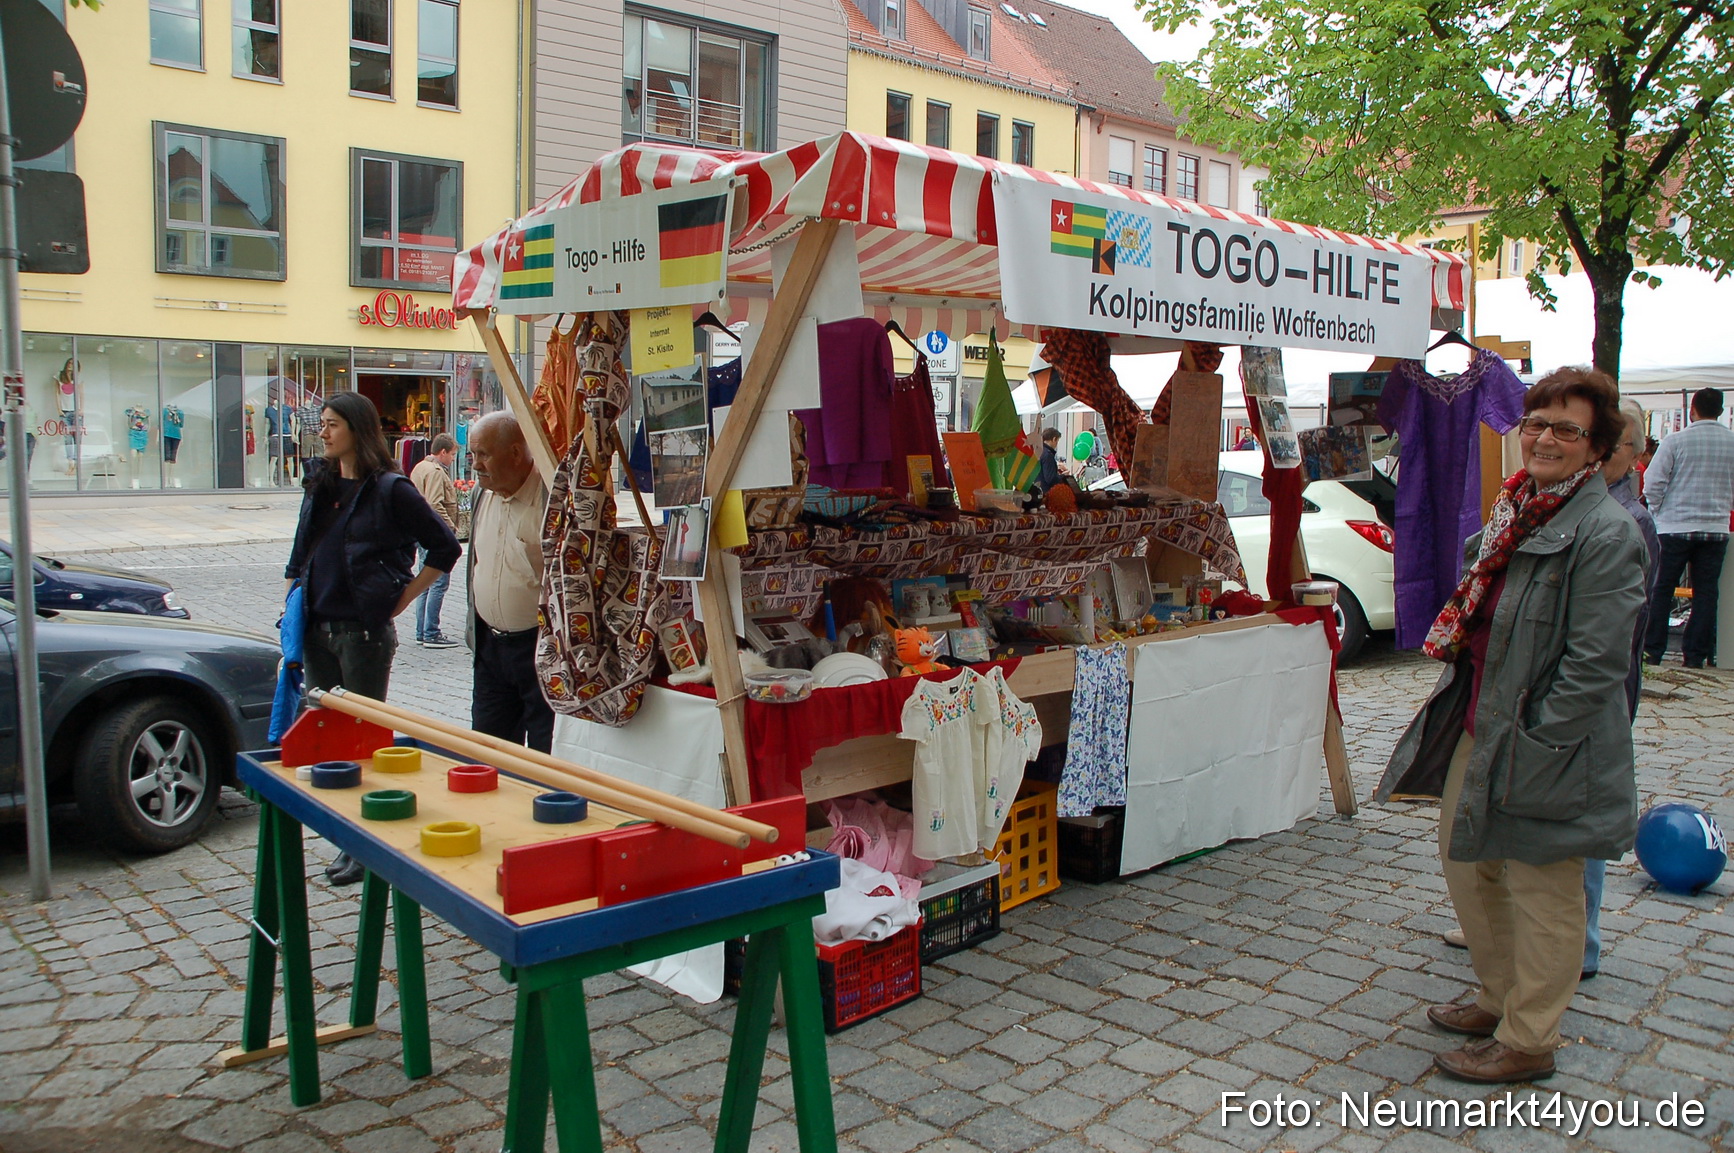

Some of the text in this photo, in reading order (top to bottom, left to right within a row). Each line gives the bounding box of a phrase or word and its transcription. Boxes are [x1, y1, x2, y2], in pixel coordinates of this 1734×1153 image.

[565, 247, 598, 273] Togo
[612, 238, 646, 264] Hilfe
[359, 289, 458, 330] s.Oliver
[647, 306, 672, 320] Projekt:
[1089, 283, 1376, 344] Kolpingsfamilie Woffenbach
[650, 327, 671, 338] Internat
[656, 343, 674, 355] Kisito
[964, 345, 1006, 362] WEBR
[926, 359, 947, 369] ZONE
